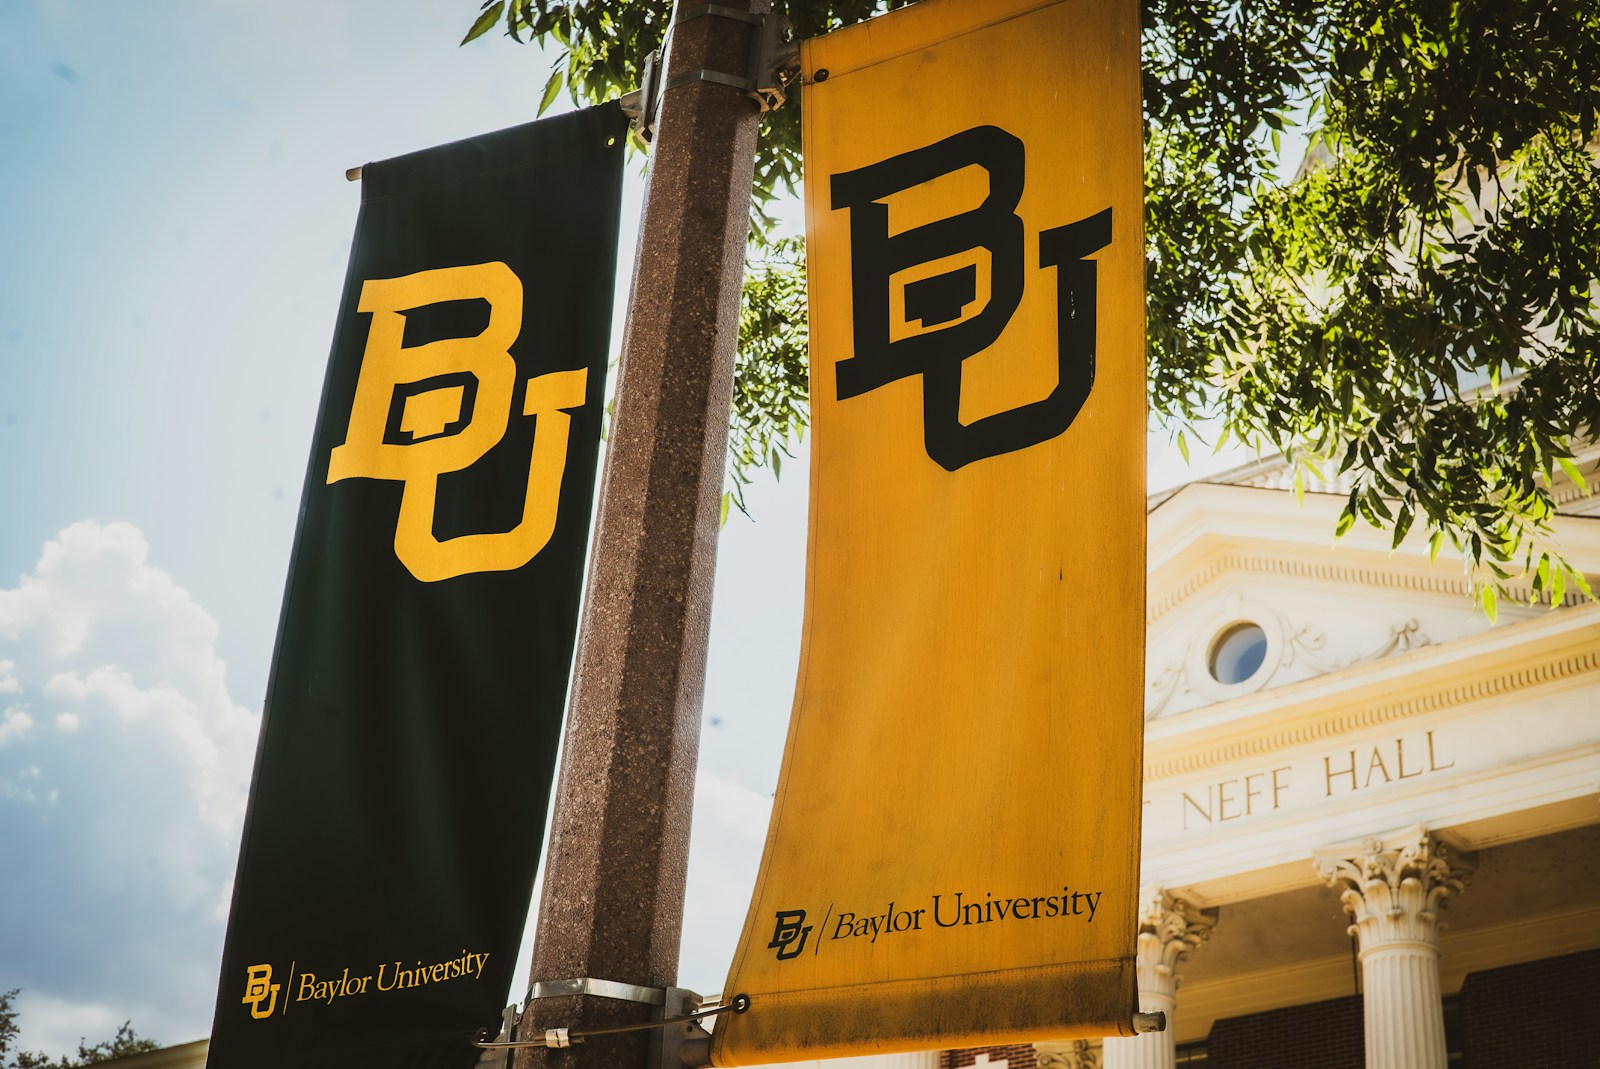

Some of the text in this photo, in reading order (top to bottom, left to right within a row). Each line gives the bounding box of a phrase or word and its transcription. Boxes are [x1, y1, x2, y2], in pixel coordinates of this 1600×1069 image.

[830, 125, 1113, 472] BU
[326, 261, 589, 583] BU
[1181, 730, 1456, 830] NEFF HALL
[831, 901, 926, 943] Baylor
[932, 886, 1103, 928] University
[296, 967, 373, 1005] Baylor
[376, 948, 490, 992] University
